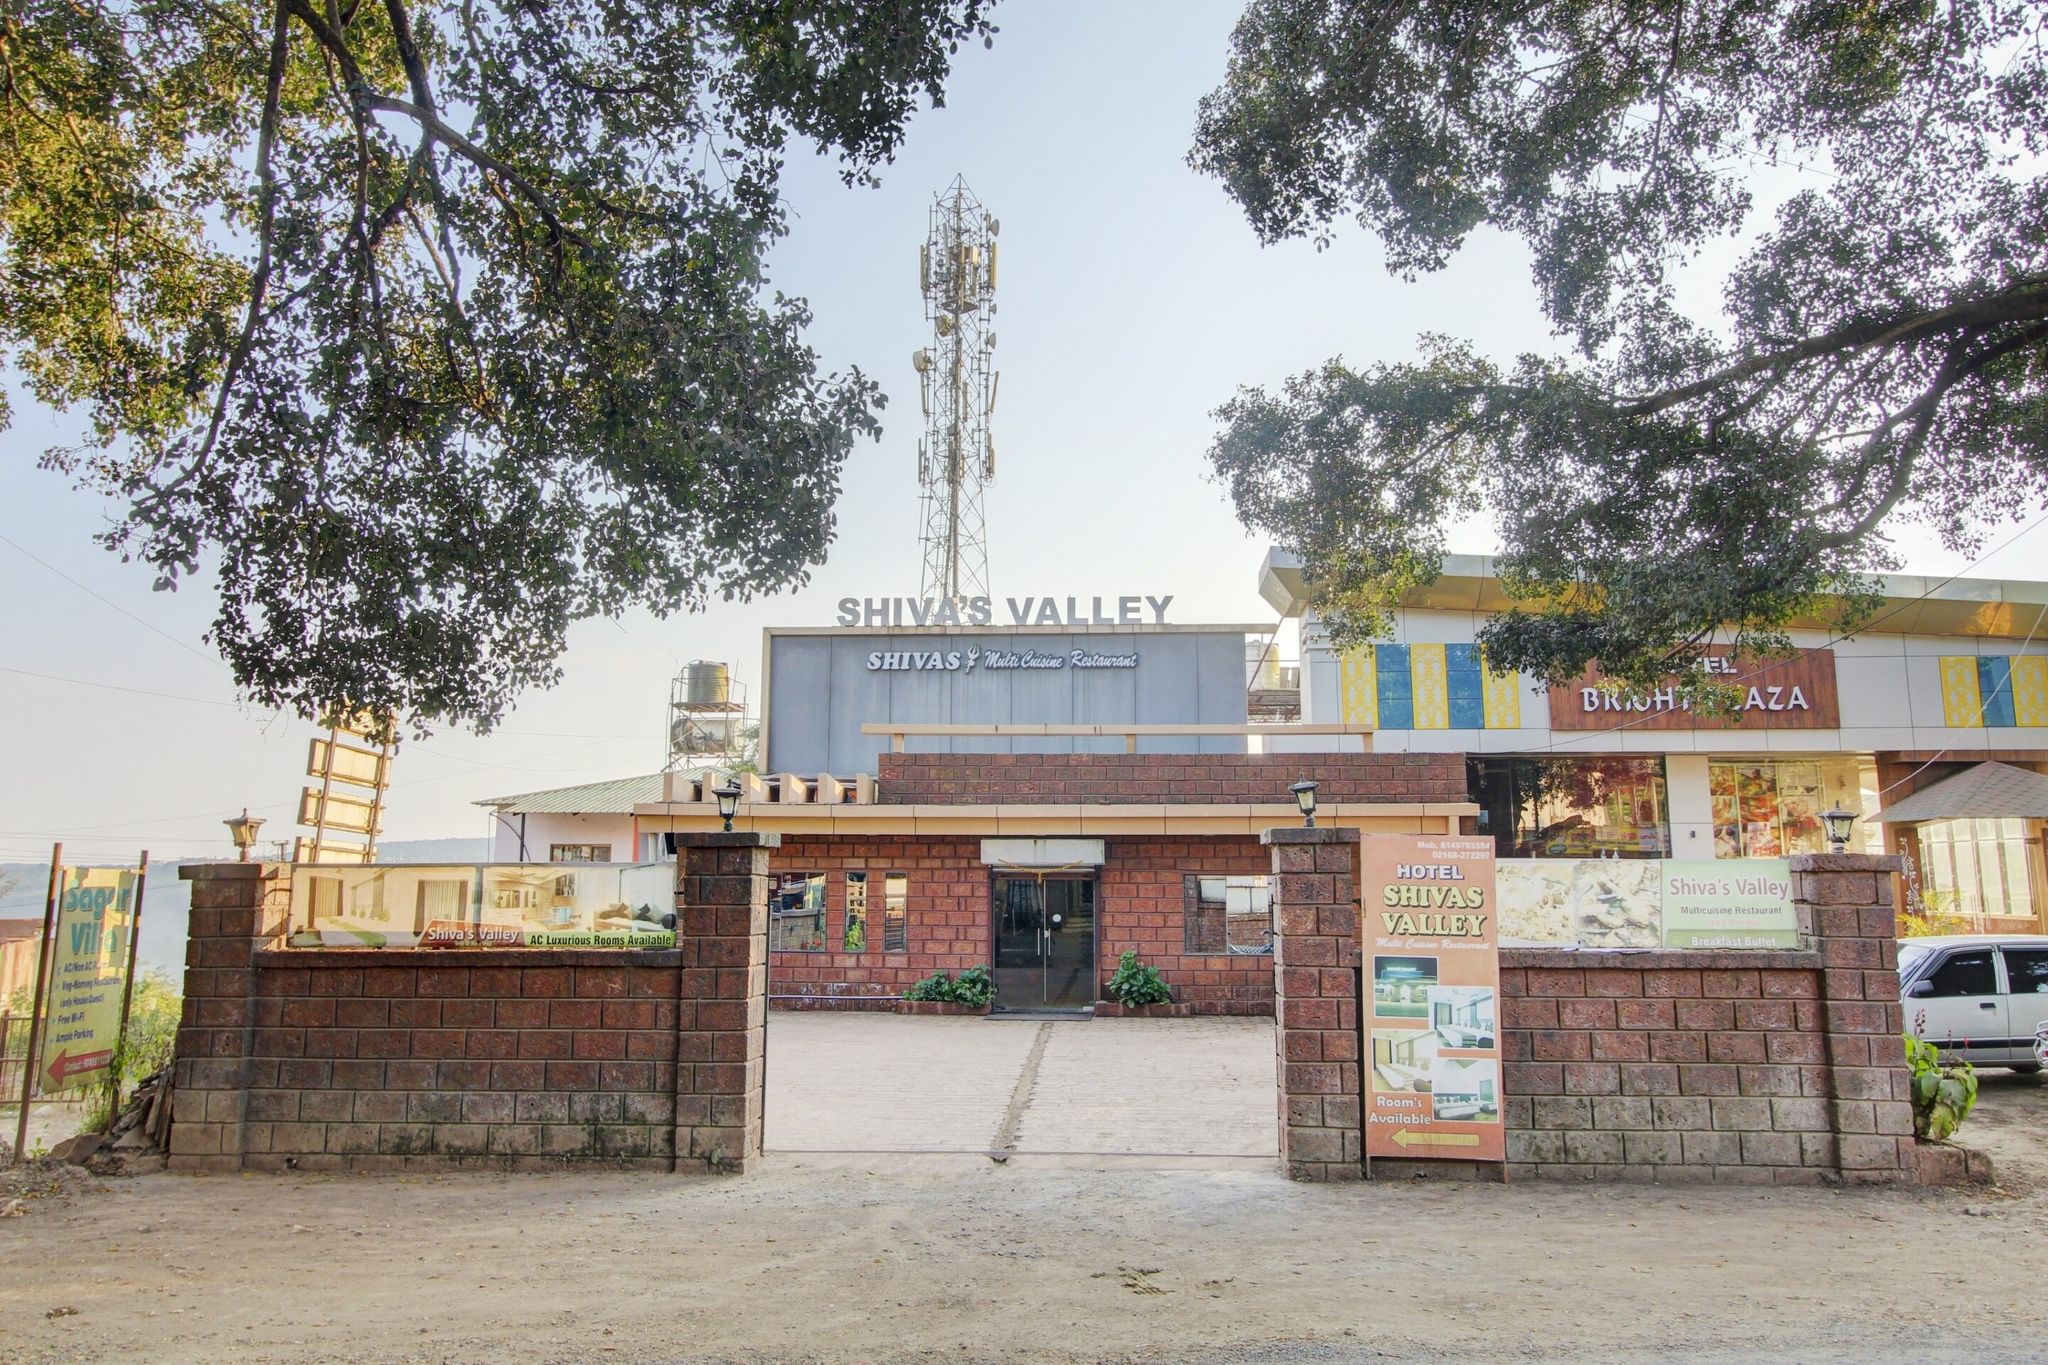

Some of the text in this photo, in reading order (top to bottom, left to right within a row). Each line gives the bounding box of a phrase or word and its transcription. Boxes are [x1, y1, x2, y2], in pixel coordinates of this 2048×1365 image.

[836, 595, 1173, 626] SHIVA'S VALLEY
[866, 649, 1137, 671] SHIVAS Multi Cuisine Restaurant
[1710, 686, 1809, 711] AZA
[1396, 864, 1464, 880] HOTEL
[1383, 884, 1484, 908] SHIVAS
[1669, 877, 1788, 900] Shiva's Valley
[1680, 906, 1782, 915] Multicuisine Restaurant
[1380, 912, 1487, 937] VALLEY
[428, 927, 475, 941] Shiva's
[479, 927, 519, 944] Valley
[530, 934, 671, 946] AC Luxurious Rooms Available
[1691, 936, 1776, 947] Breakfast Buffet
[73, 1029, 94, 1039] Parking
[1376, 1096, 1423, 1108] Room's
[1369, 1112, 1431, 1125] Available
